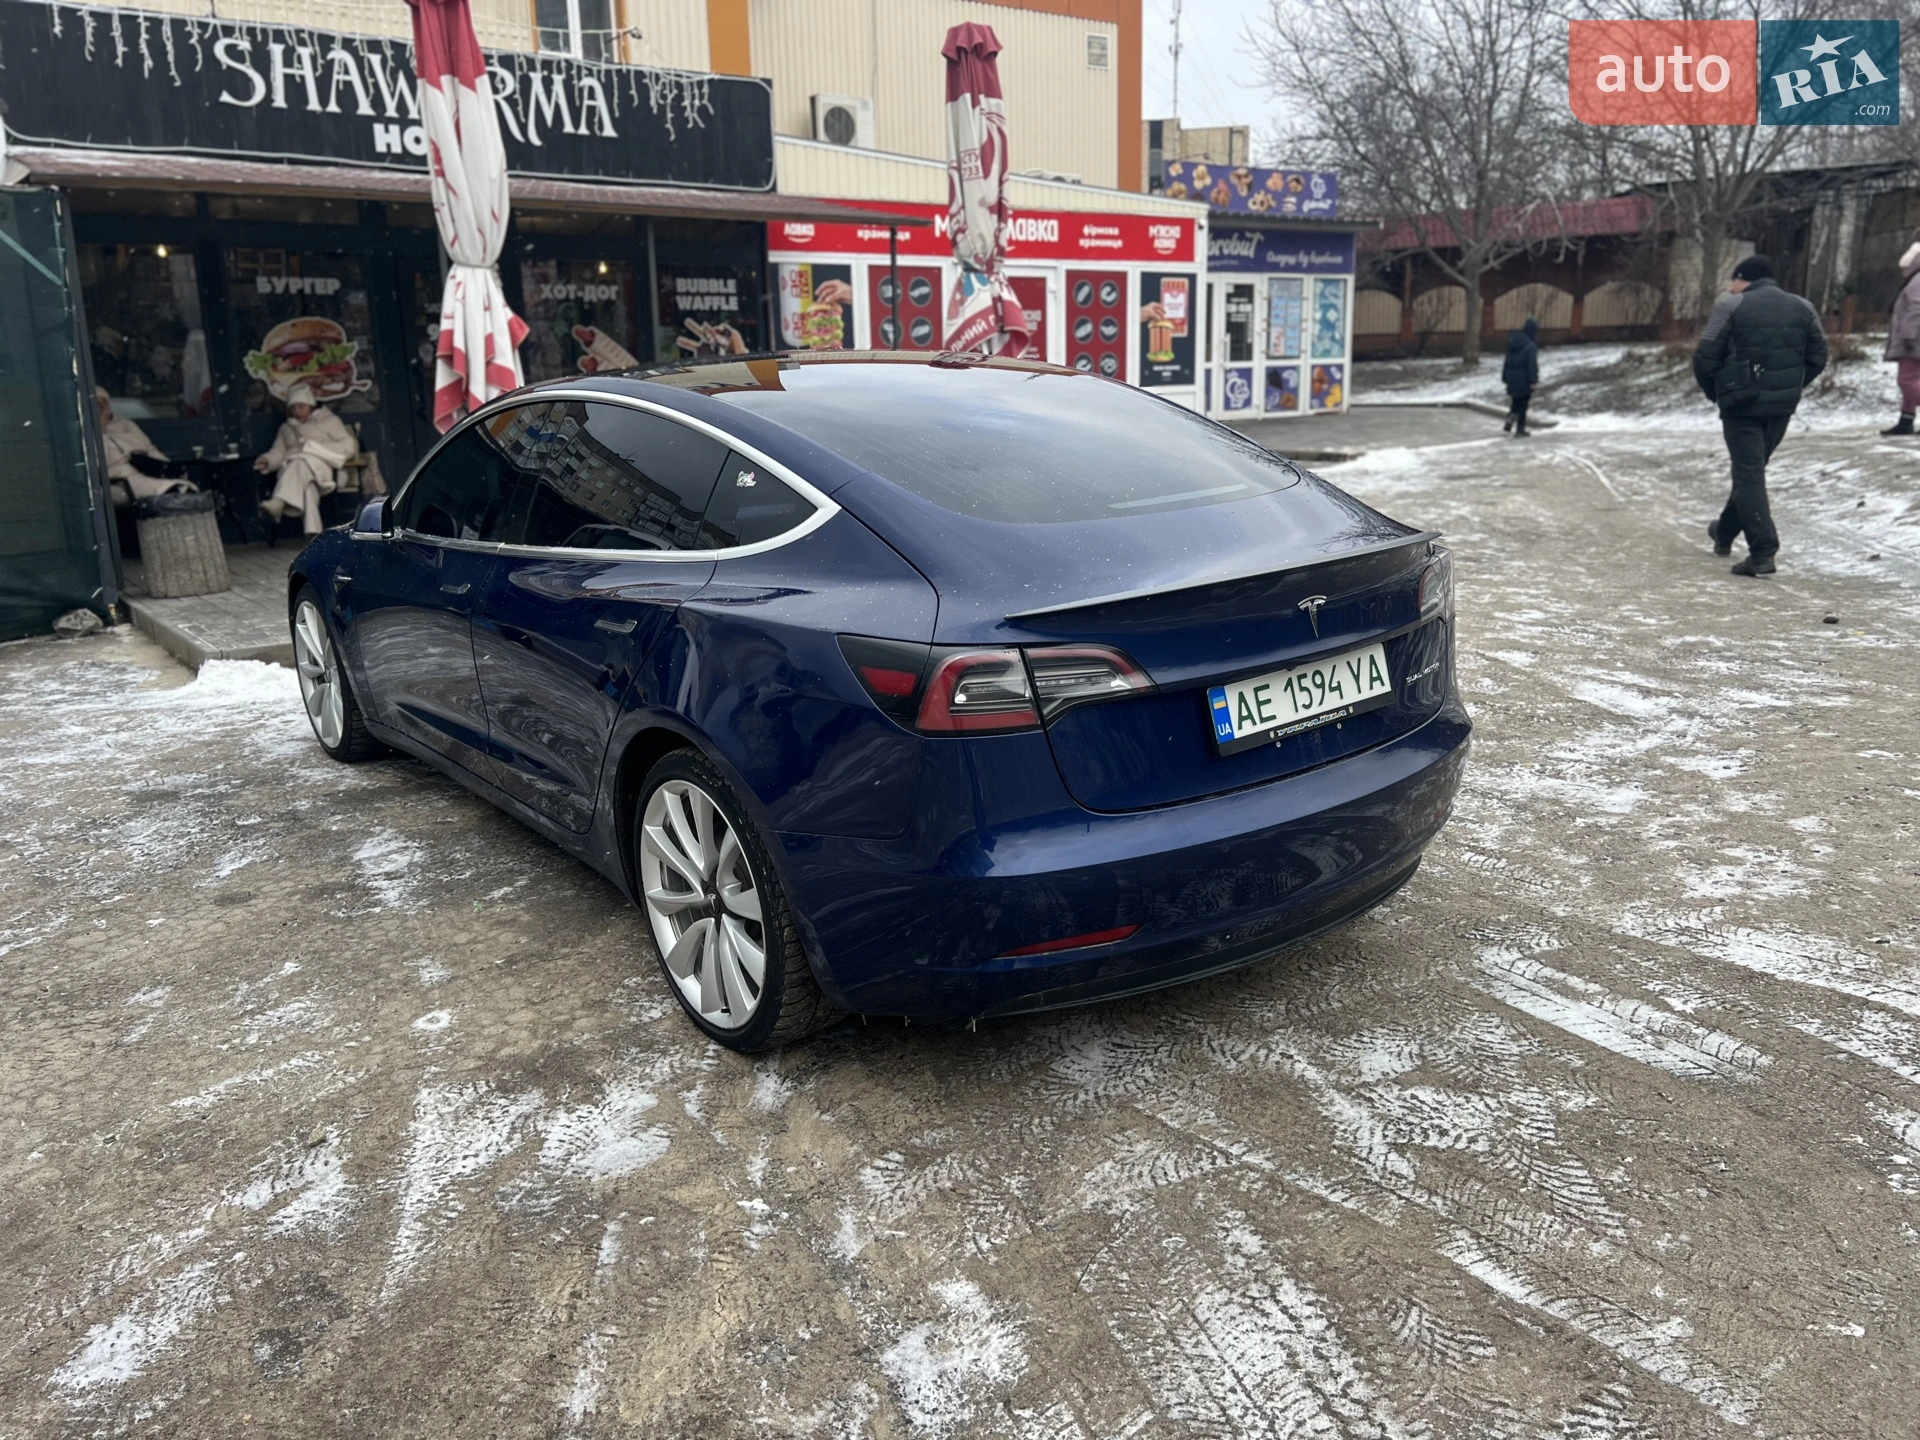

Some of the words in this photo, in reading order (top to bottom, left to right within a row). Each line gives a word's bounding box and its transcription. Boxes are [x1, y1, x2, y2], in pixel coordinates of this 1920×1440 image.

[213, 37, 619, 147] SHAWRMA
[256, 275, 341, 295] БУРГЕР
[540, 283, 620, 303] ХОТ-ДОГ
[676, 277, 737, 294] BUBBLE
[676, 295, 739, 311] WAFFLE
[1236, 683, 1277, 730] AE
[1283, 664, 1344, 714] 1594
[1346, 653, 1385, 694] YA
[1217, 723, 1233, 737] UA
